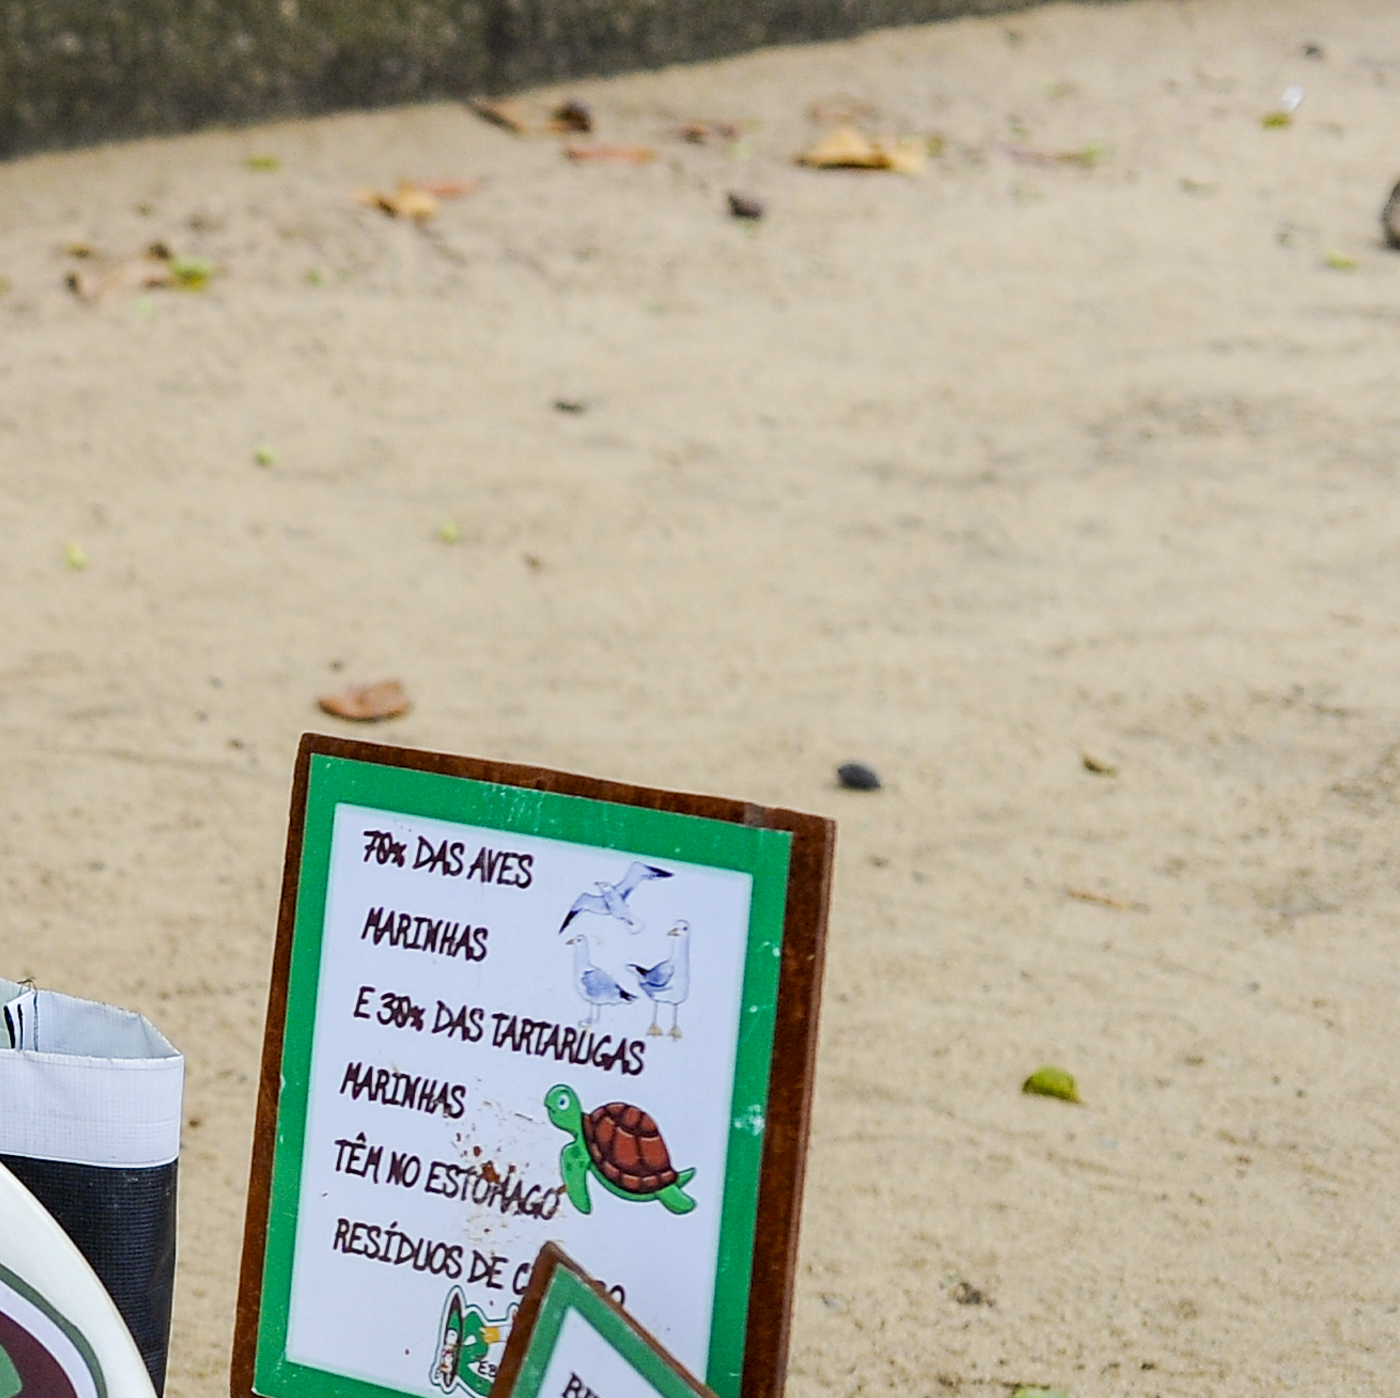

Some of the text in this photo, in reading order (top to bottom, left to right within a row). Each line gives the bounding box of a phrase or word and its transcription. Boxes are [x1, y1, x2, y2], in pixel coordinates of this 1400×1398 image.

[362, 830, 533, 889] 70% DAS AVES
[361, 906, 488, 962] MARINHAS
[353, 986, 646, 1077] E 30% DAS TARTARUGAS
[339, 1062, 468, 1120] MARINHAS
[334, 1131, 384, 1185] TÊM
[386, 1149, 421, 1188] NO
[333, 1218, 464, 1279] RESÍDUOS
[467, 1250, 509, 1289] DE
